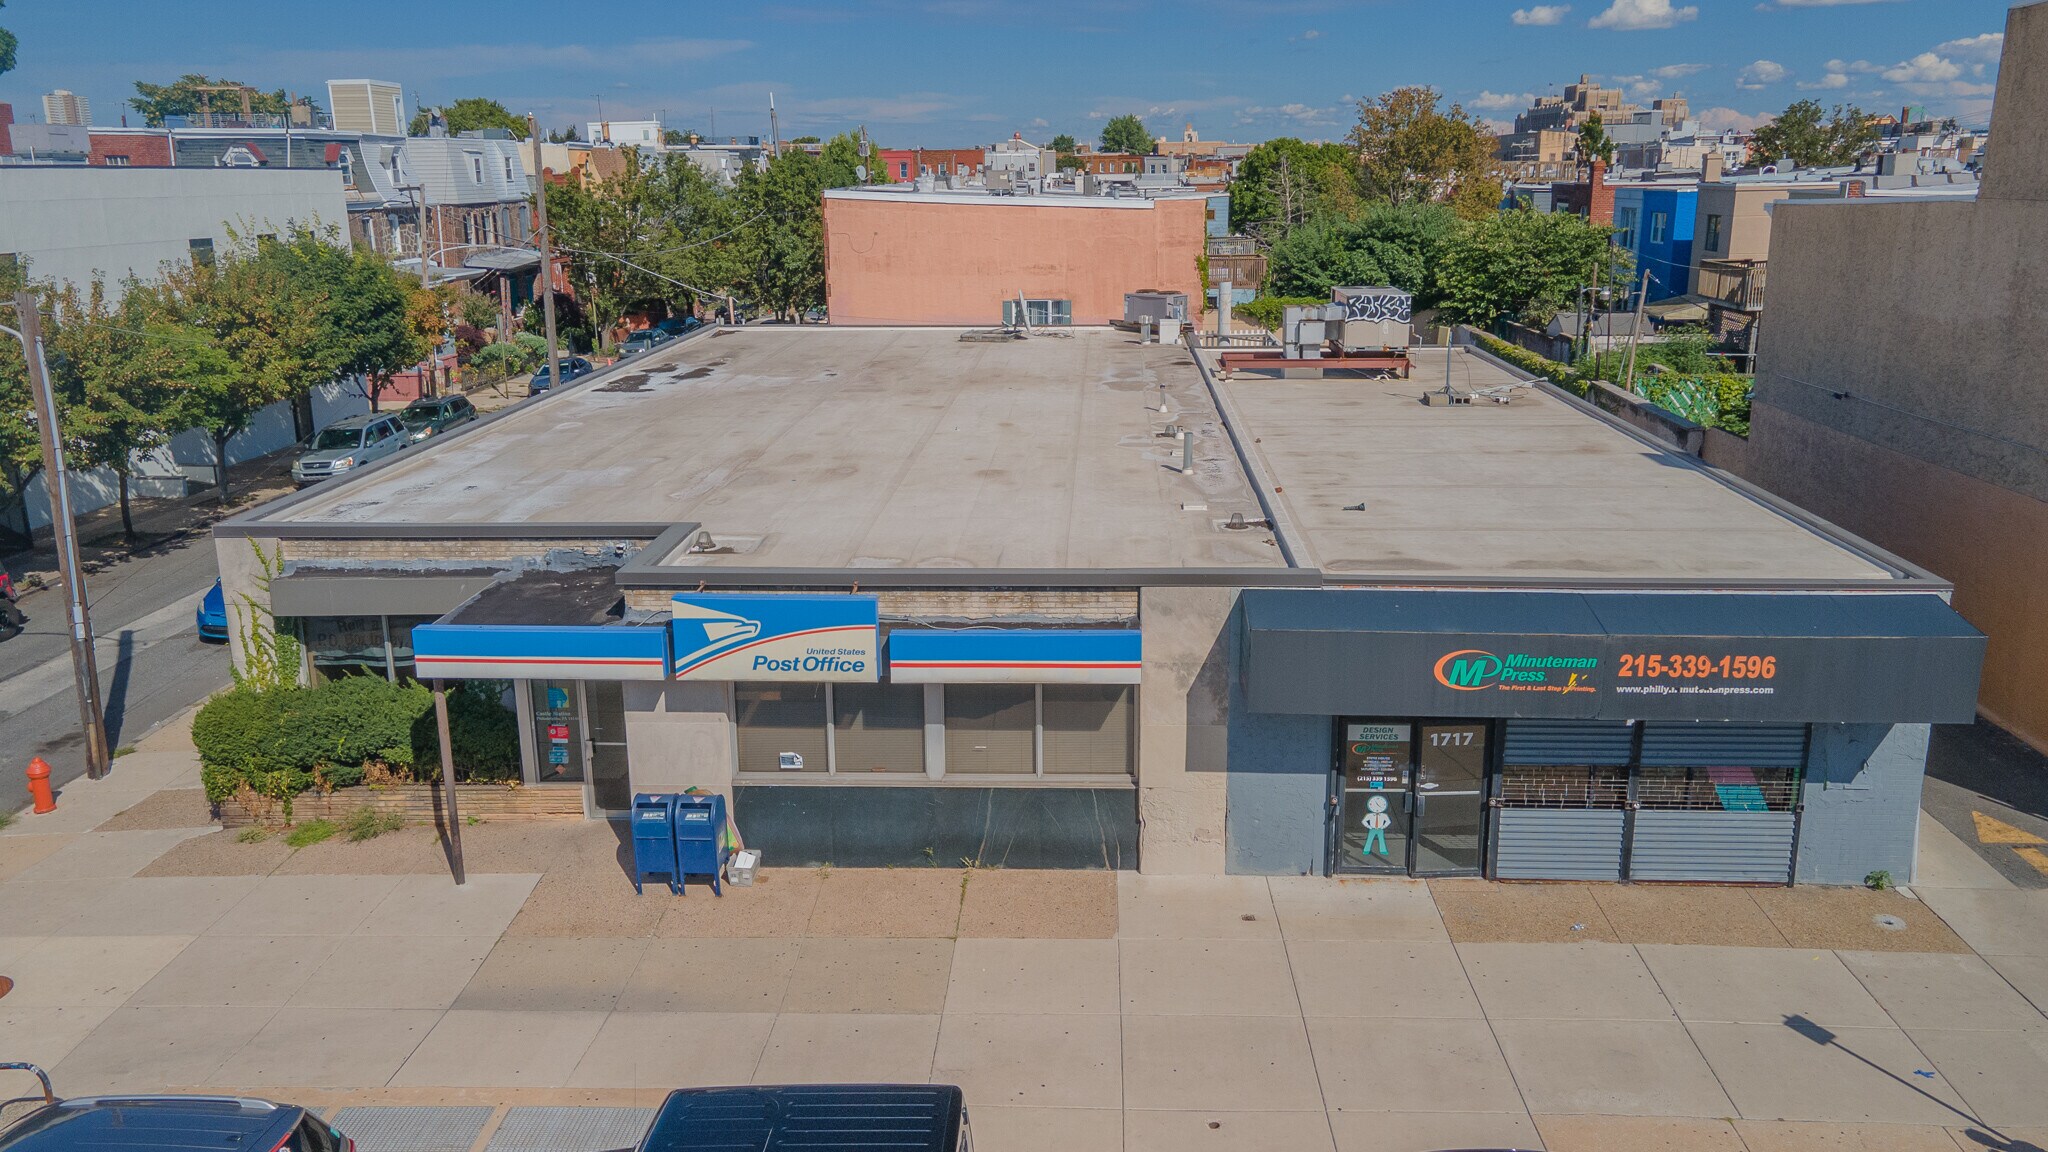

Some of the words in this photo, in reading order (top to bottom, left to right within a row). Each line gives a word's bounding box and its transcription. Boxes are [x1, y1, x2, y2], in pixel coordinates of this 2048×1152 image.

[752, 655, 800, 672] Post
[802, 656, 865, 672] Office
[1505, 653, 1598, 668] Minuteman
[1618, 654, 1776, 679] 215-339-1596
[1430, 732, 1474, 746] 1717
